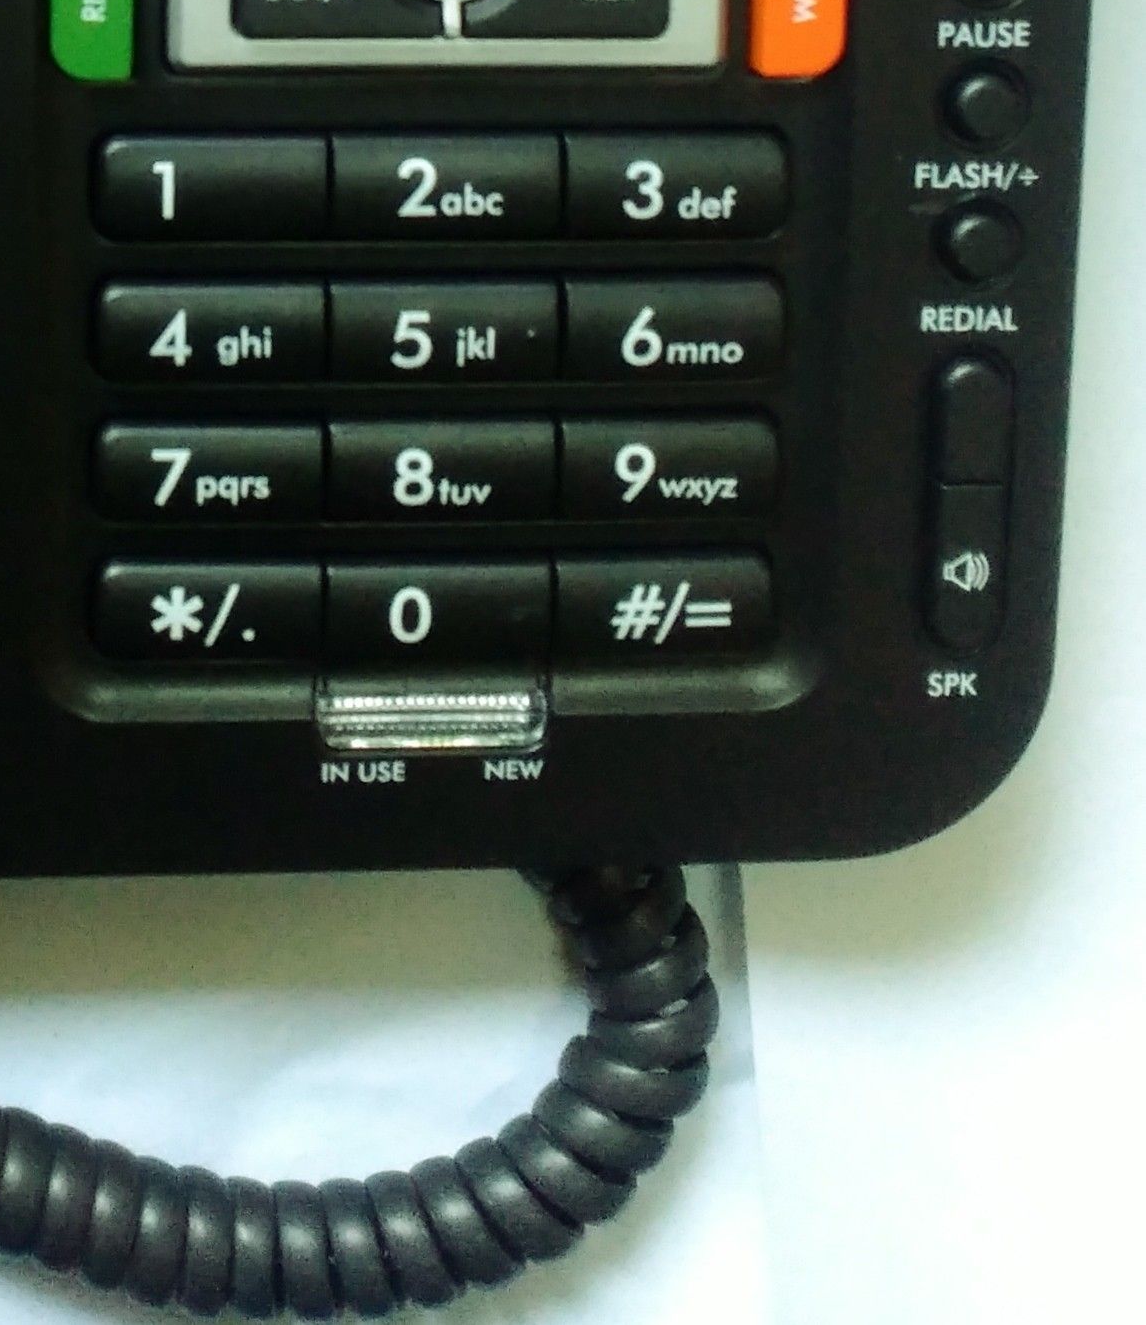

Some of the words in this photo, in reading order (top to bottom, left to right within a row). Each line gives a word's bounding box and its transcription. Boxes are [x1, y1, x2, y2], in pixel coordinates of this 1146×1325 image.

[938, 21, 1031, 47] PAUSE
[151, 162, 176, 219] 1
[622, 161, 664, 220] 3
[678, 188, 737, 221] def
[150, 310, 192, 366] 4
[216, 328, 273, 364] ghi
[391, 311, 432, 368] 5
[455, 328, 496, 364] jkl
[920, 307, 1017, 333] REDIAL
[150, 449, 191, 506] 7
[196, 472, 271, 506] pqrs
[389, 588, 432, 644] 0
[927, 673, 977, 697] SPK
[320, 762, 349, 783] IN
[358, 762, 406, 783] USE
[484, 759, 543, 782] NEW
